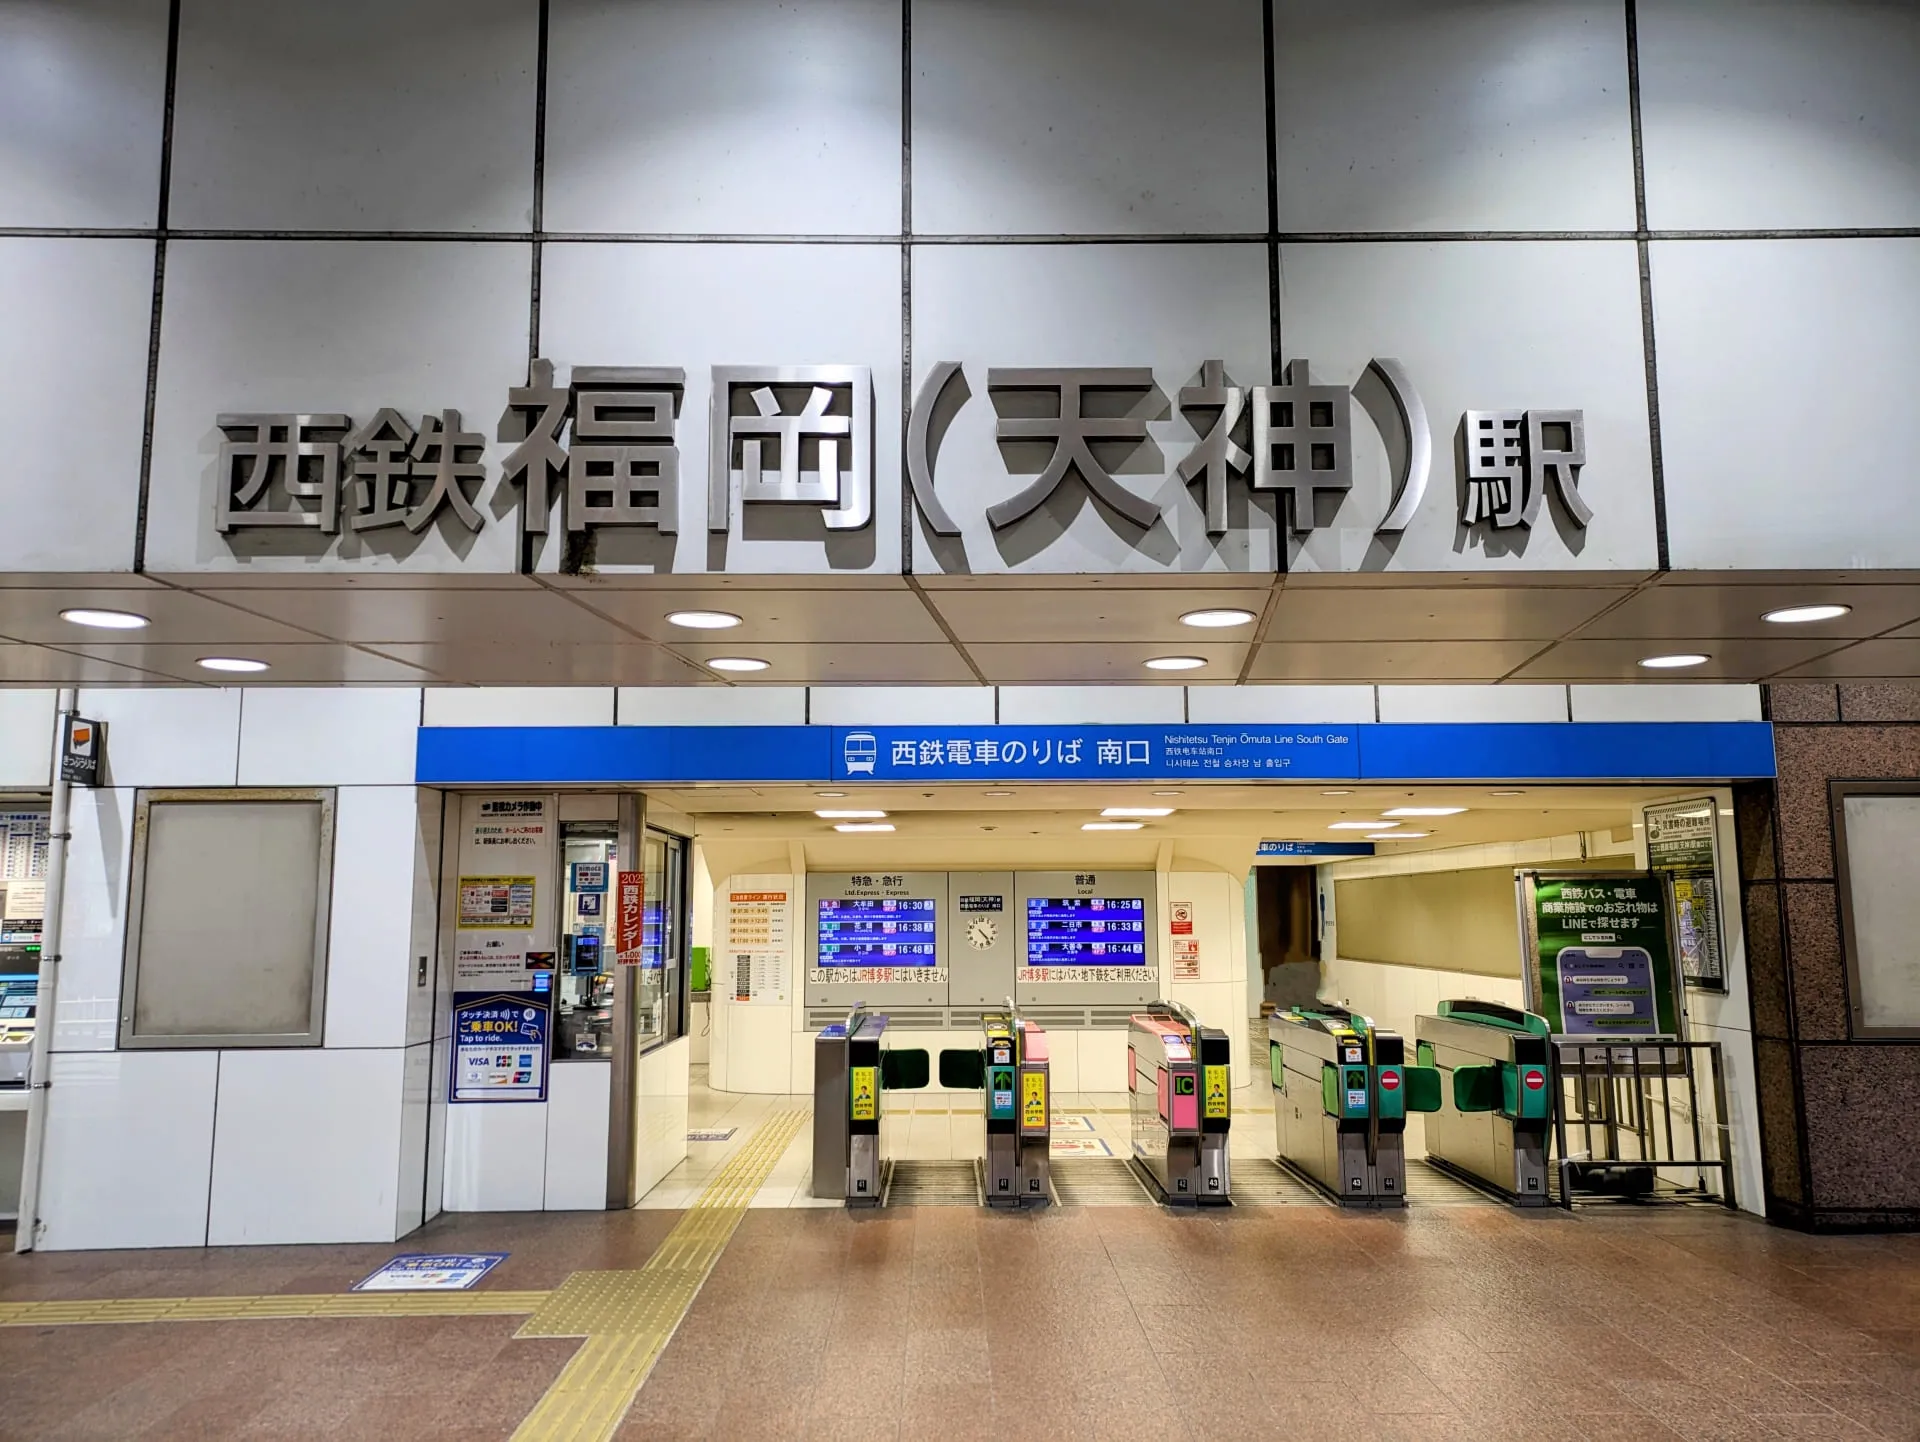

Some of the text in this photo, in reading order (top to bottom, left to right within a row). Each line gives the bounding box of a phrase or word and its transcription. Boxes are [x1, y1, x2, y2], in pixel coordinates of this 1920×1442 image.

[216, 357, 1594, 536] 西鉄福岡(天神)駅
[1164, 734, 1208, 744] Nishitetsu
[1212, 734, 1237, 746] Tenjin
[1274, 734, 1293, 744] Line
[1296, 734, 1323, 744] South
[1326, 734, 1349, 744] Gate
[891, 738, 1151, 767] 西鉄電車のりば 南口
[62, 755, 97, 770] きっぷうりば
[851, 875, 903, 887] 特急・急行
[1074, 874, 1096, 886] 普通
[1560, 887, 1637, 900] 西鉄バス・電車
[898, 902, 923, 910] 16:30
[1106, 901, 1131, 909] 16:25
[1541, 901, 1659, 914] 商業施設でのお忘れ物は
[623, 885, 639, 950] 西鉄カレンダー
[1562, 917, 1640, 929] LINEで探せます
[898, 924, 923, 932] 16:38
[1107, 923, 1131, 931] 16:33
[898, 946, 923, 954] 16:48
[1107, 945, 1132, 953] 16:44
[810, 968, 947, 983] この駅からはJR博多駅にはいきません
[1017, 967, 1158, 981] JR博多駅にはバス・地下鉄をご利用ください。
[460, 1010, 519, 1019] タッチ決済 で
[460, 1020, 518, 1033] ご乗車OK!
[460, 1035, 474, 1043] Tap
[484, 1034, 503, 1042] ride.
[468, 1057, 490, 1066] VISA
[1175, 1077, 1194, 1094] IC
